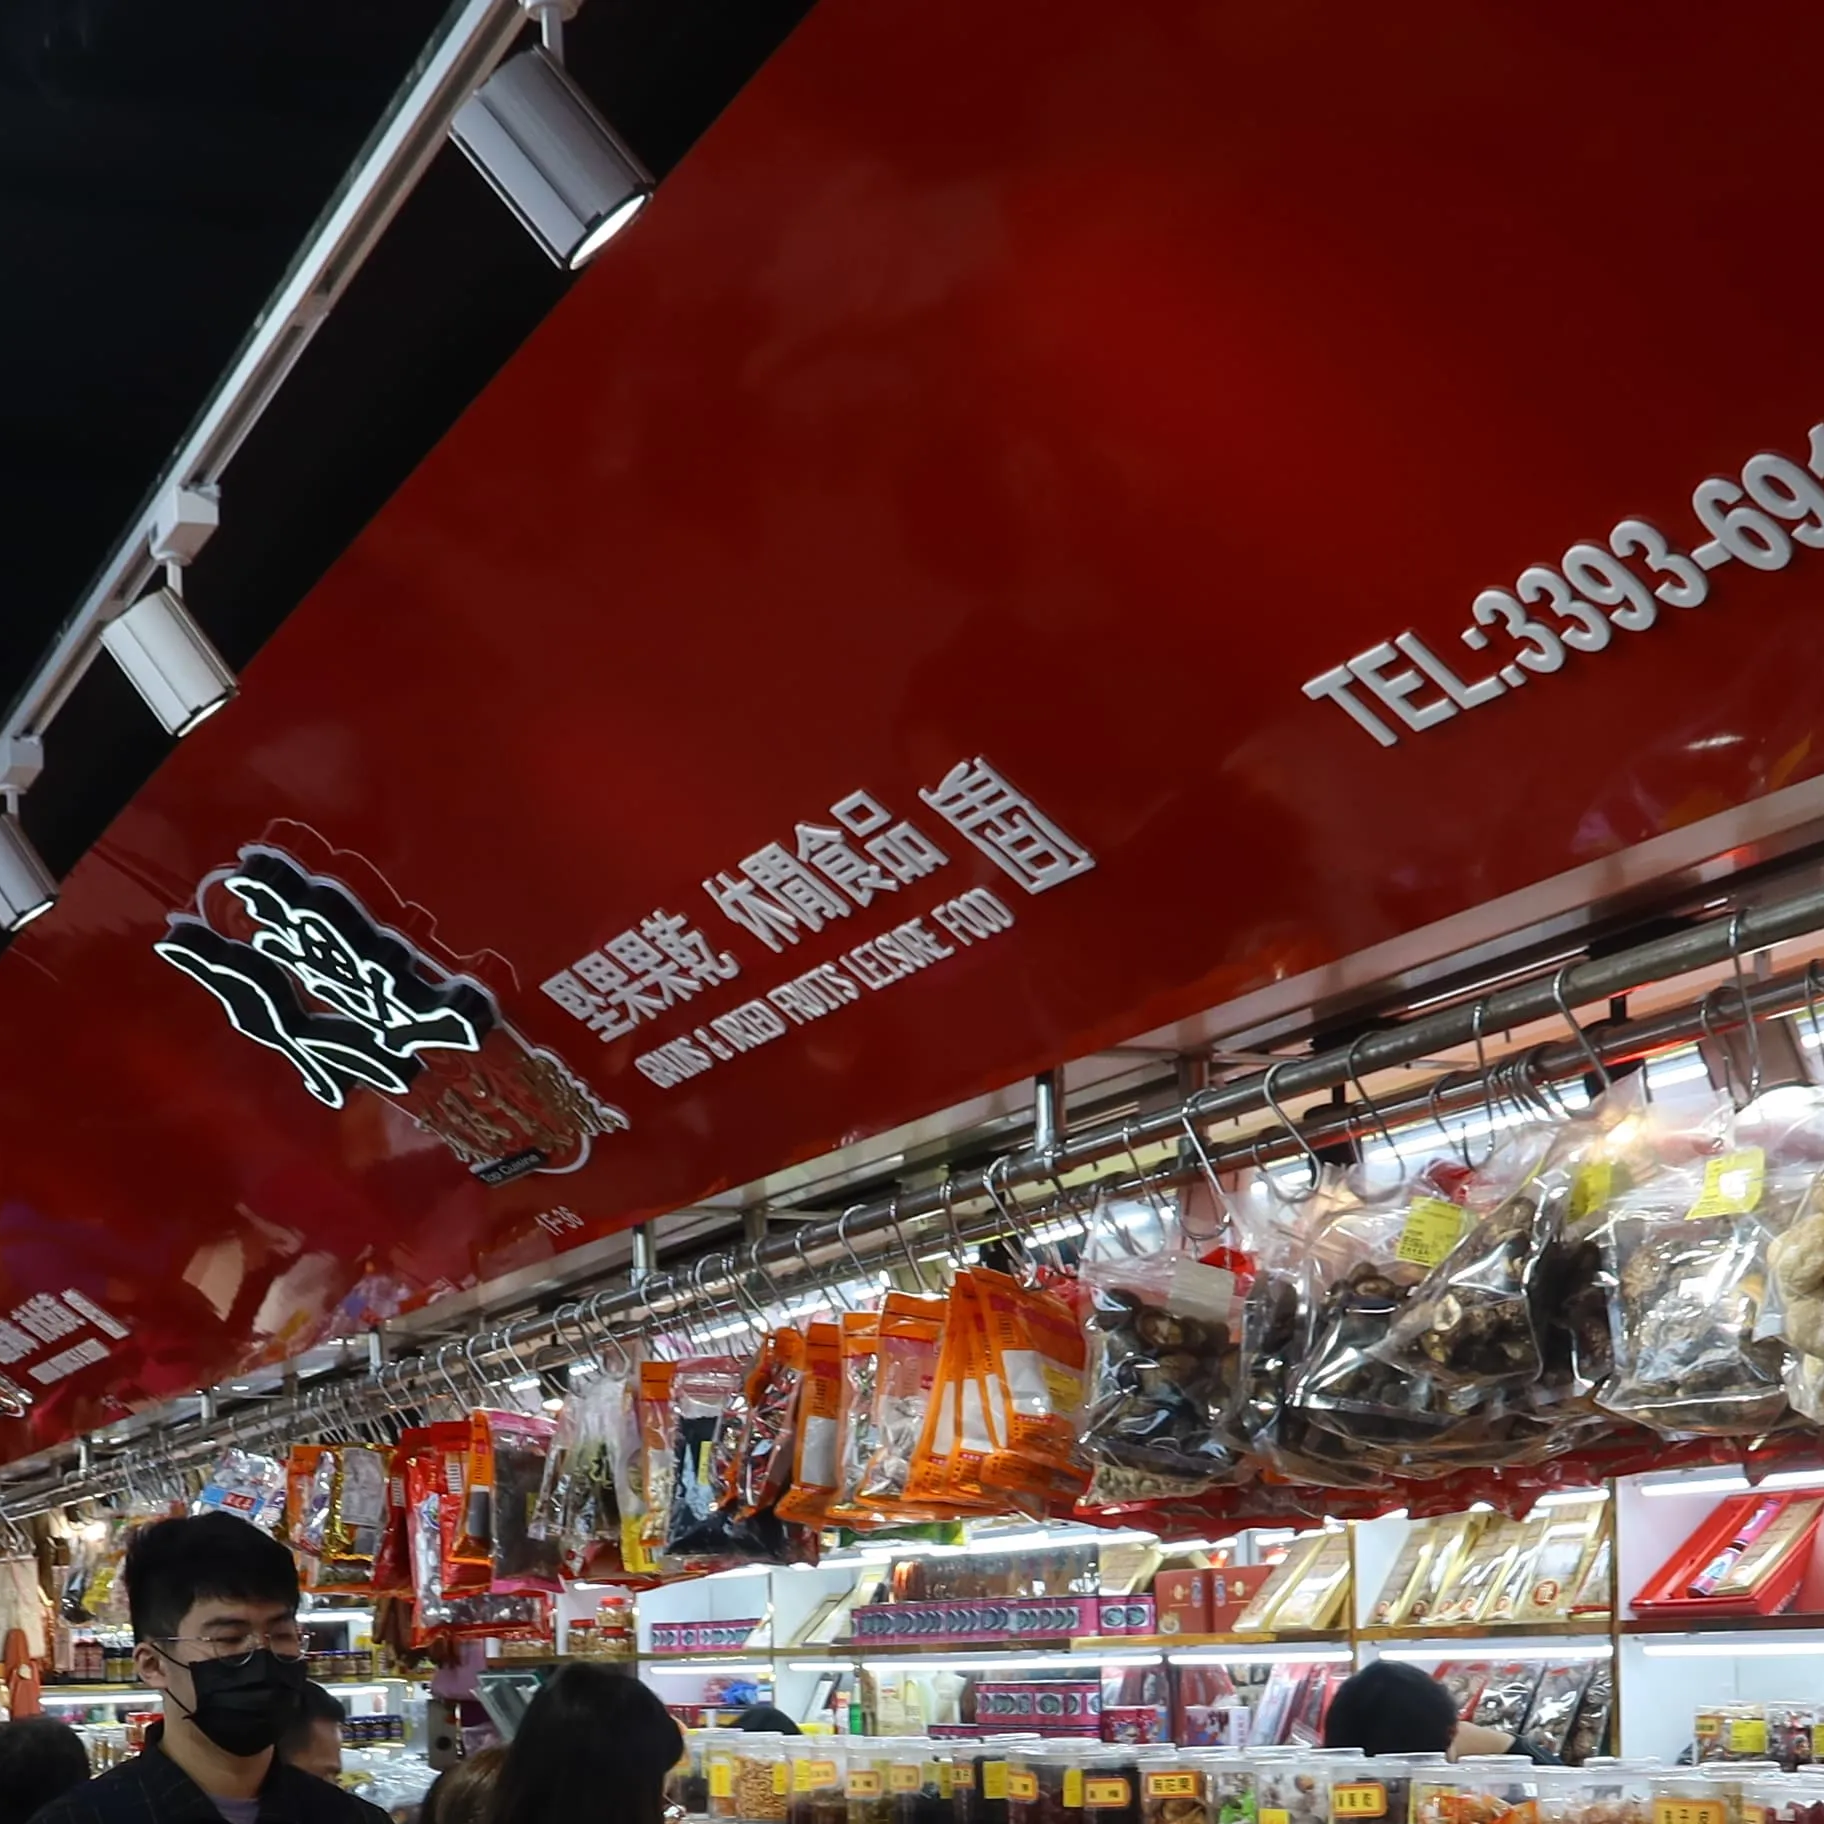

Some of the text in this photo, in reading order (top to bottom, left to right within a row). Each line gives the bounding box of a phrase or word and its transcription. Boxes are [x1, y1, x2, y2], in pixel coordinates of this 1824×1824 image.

[931, 886, 1015, 946] FOOD
[838, 916, 955, 991] LEISURE
[767, 962, 860, 1026] FRUITS
[694, 1027, 734, 1062] &
[709, 998, 787, 1054] DRIED
